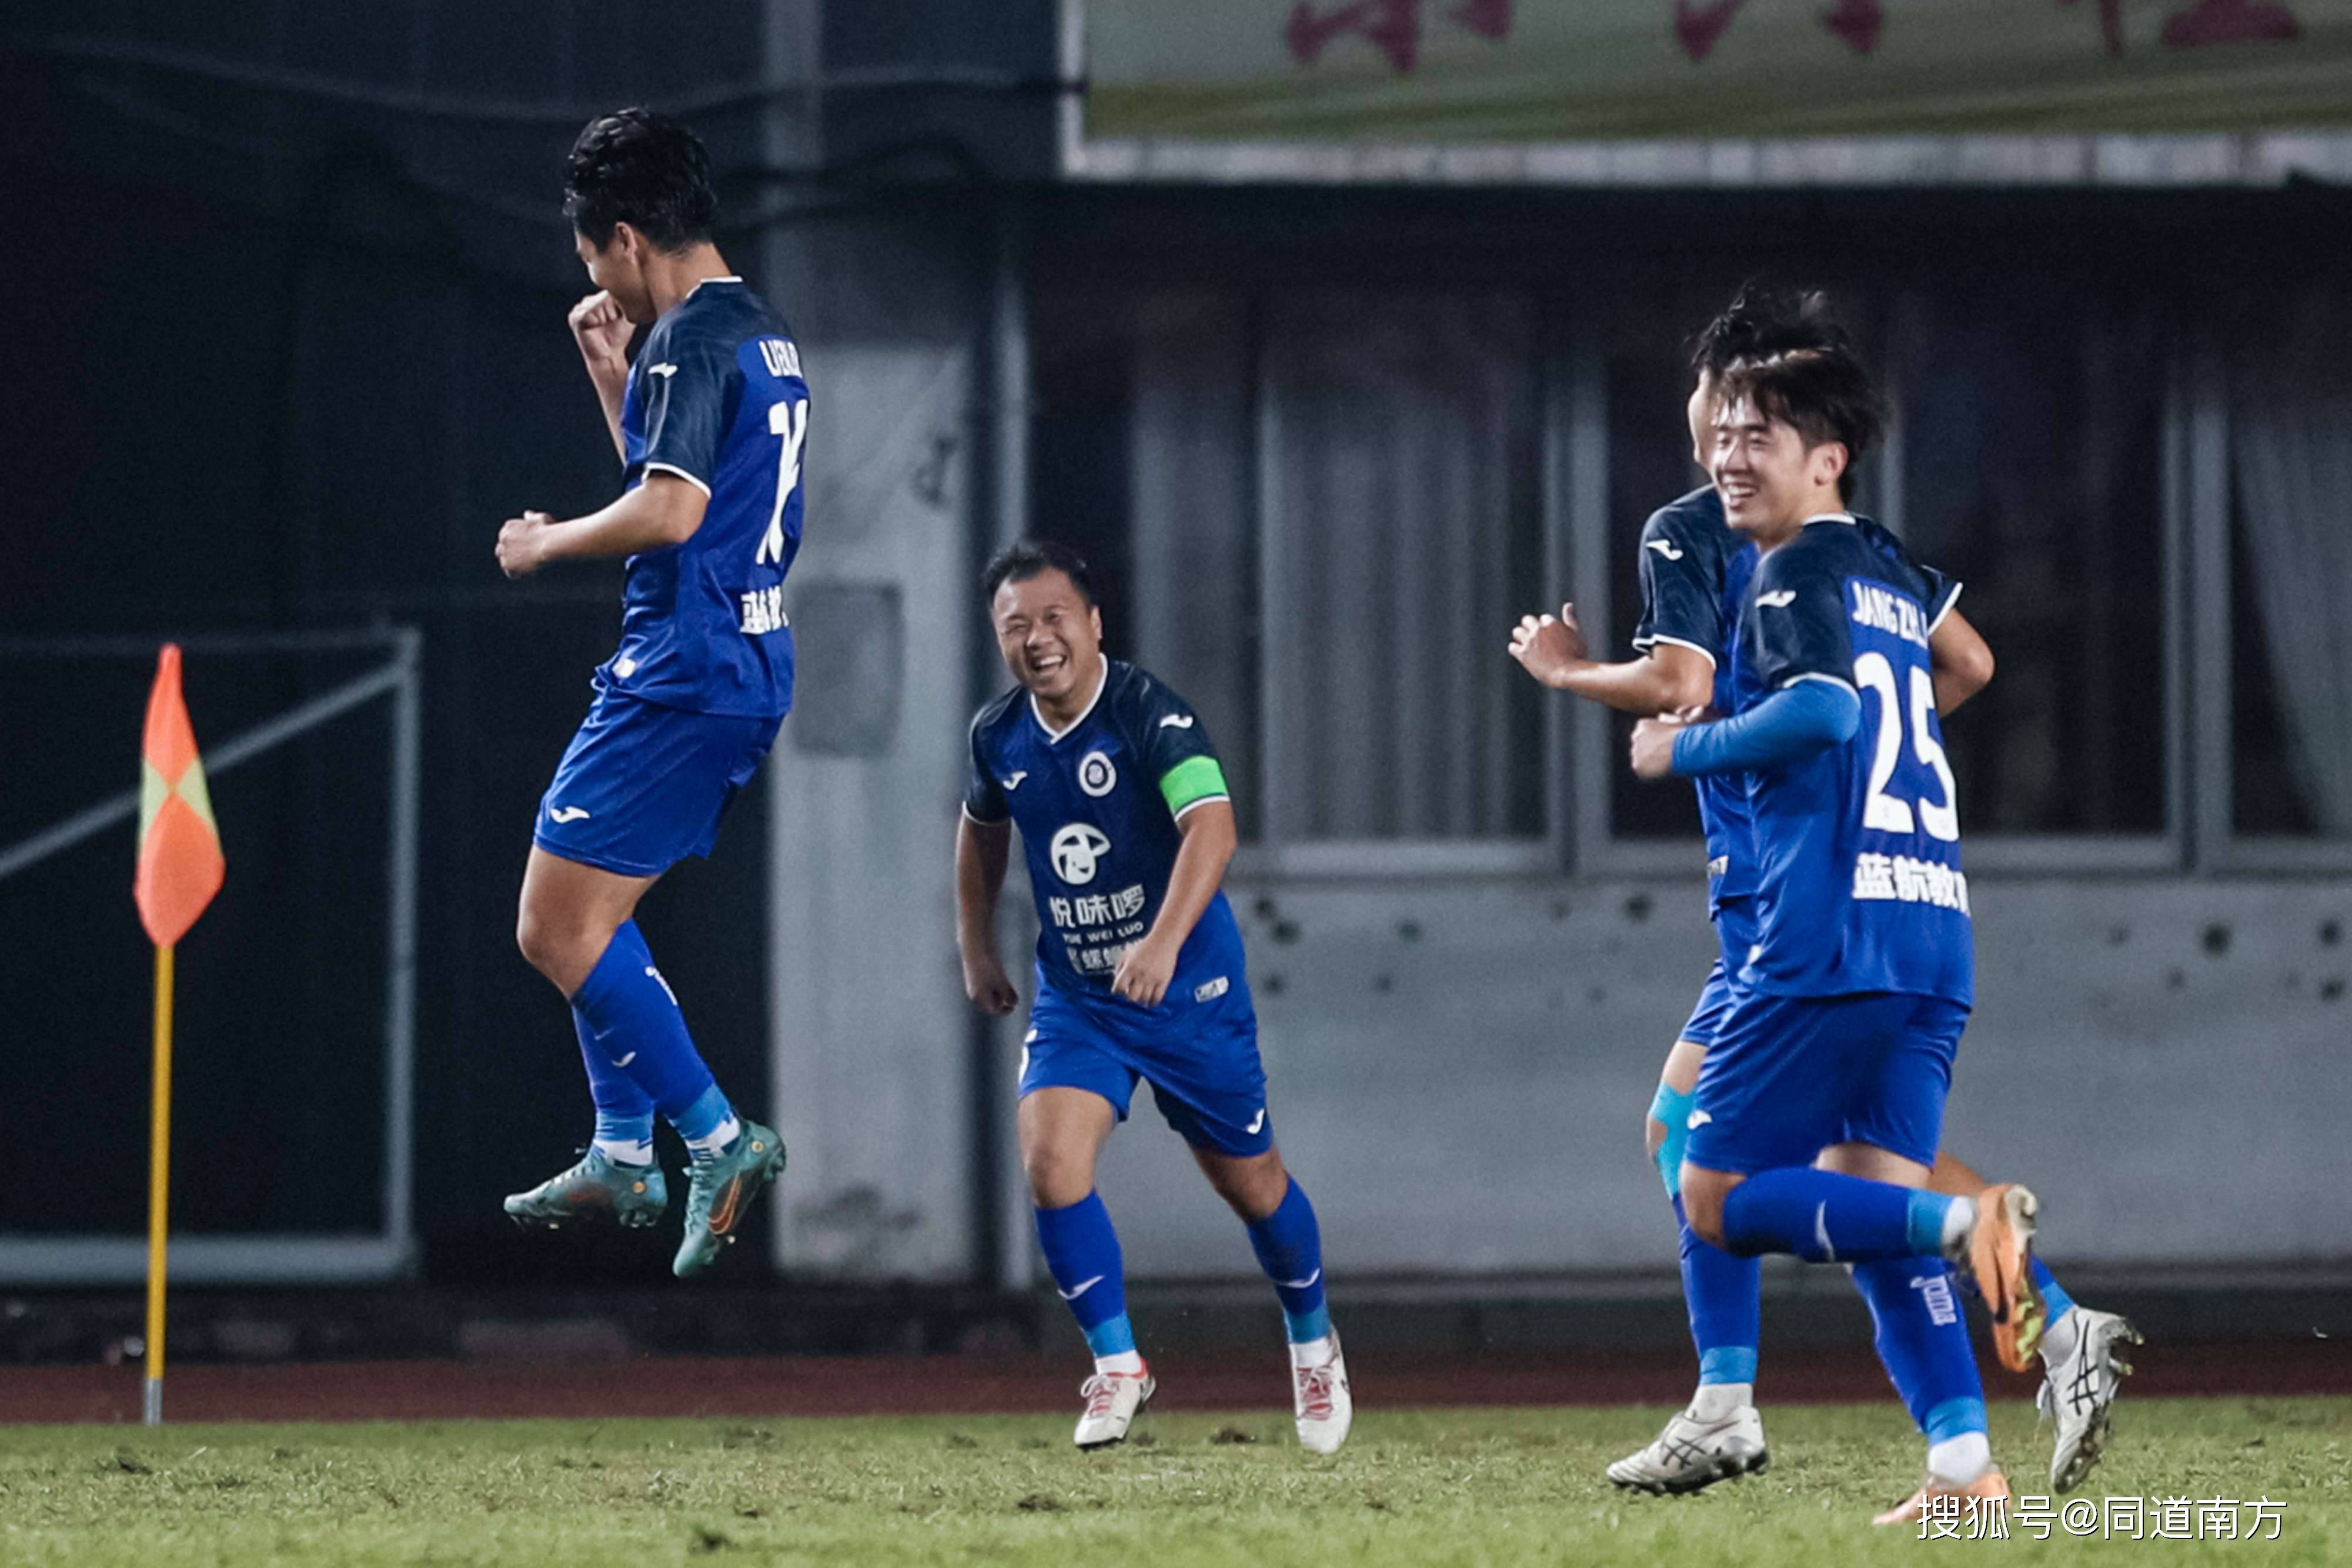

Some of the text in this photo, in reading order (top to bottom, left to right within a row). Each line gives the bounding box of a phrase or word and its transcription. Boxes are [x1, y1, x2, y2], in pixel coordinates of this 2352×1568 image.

[1853, 651, 1960, 842] 25
[1852, 851, 1971, 918] 蓝航教
[1086, 929, 1113, 943] WEI
[1117, 921, 1144, 938] LUO
